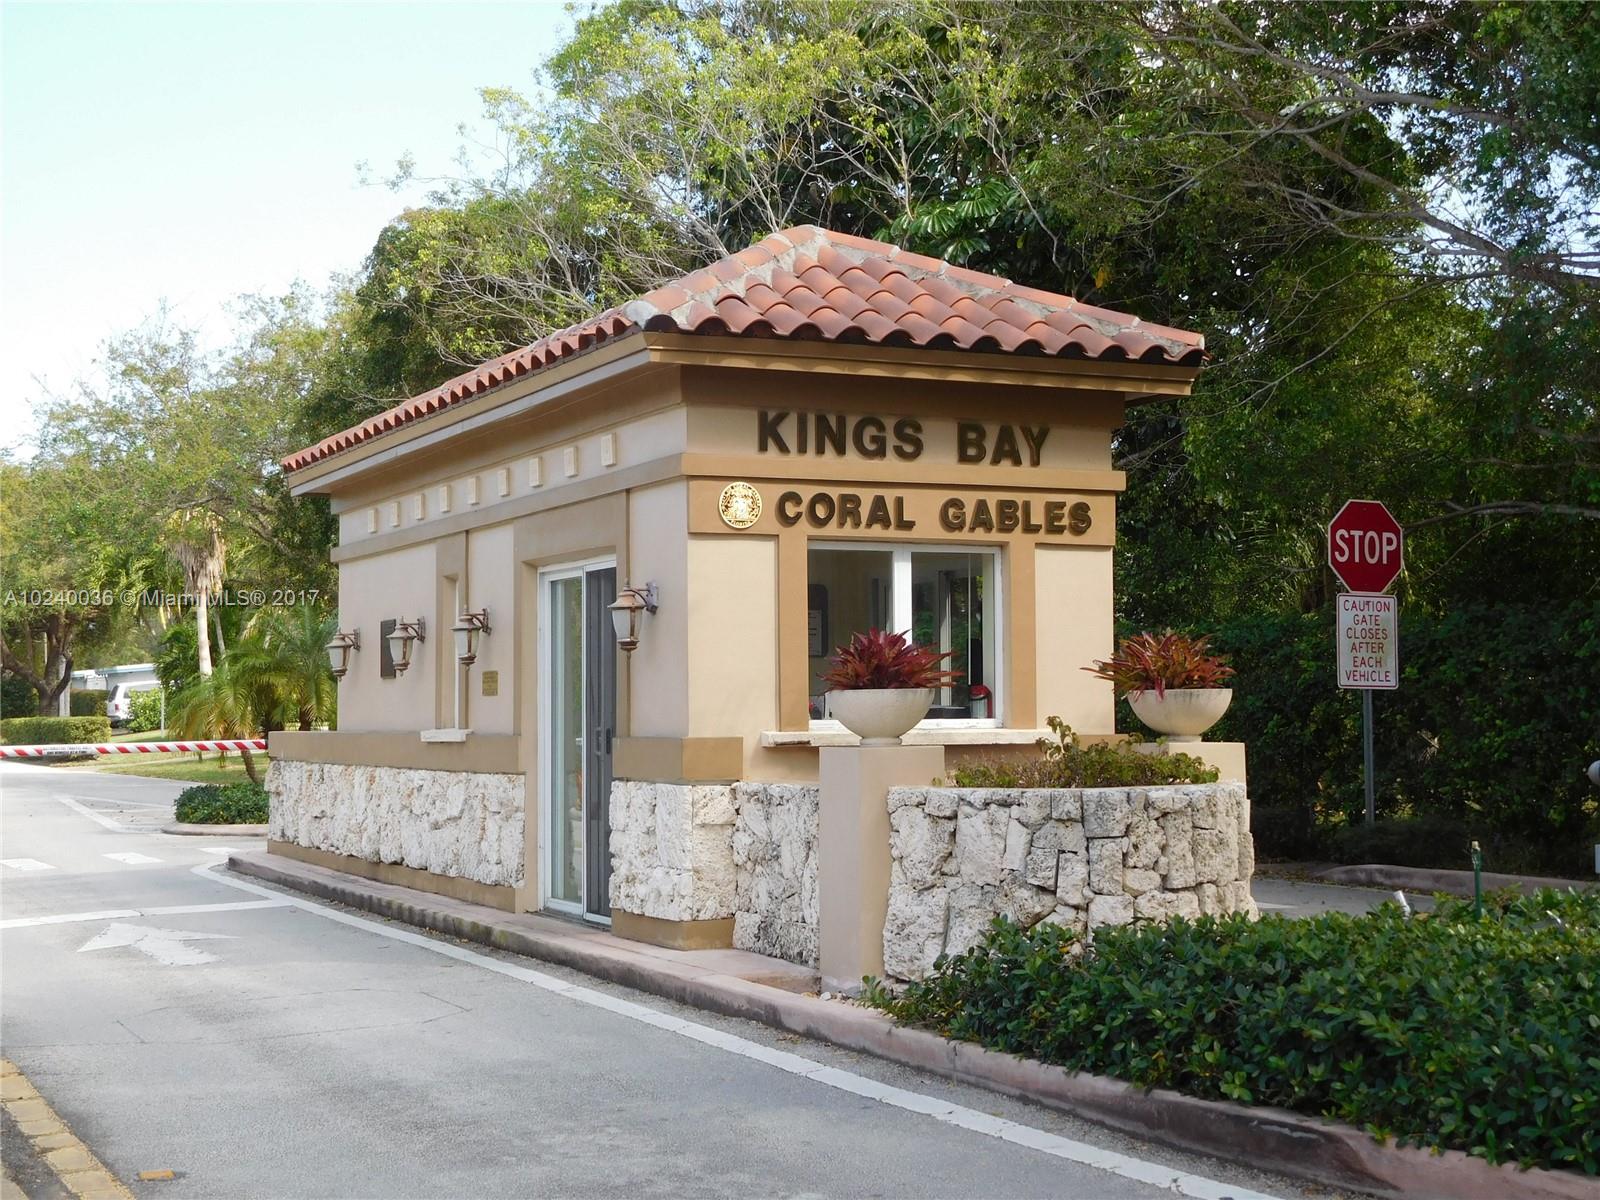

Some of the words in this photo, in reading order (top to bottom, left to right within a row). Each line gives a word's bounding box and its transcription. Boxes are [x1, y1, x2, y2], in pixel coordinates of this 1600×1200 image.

[758, 410, 923, 460] KINGS
[957, 422, 1049, 466] BAY
[776, 491, 916, 532] CORAL
[938, 498, 1092, 535] GABLES
[1335, 529, 1397, 564] STOP
[1343, 600, 1391, 612] CAUTION
[1353, 614, 1381, 626] GATE
[1346, 627, 1388, 640] CLOSES
[1351, 642, 1384, 654] AFTER
[1353, 656, 1382, 668] EACH
[1346, 670, 1391, 682] VEHICLE
